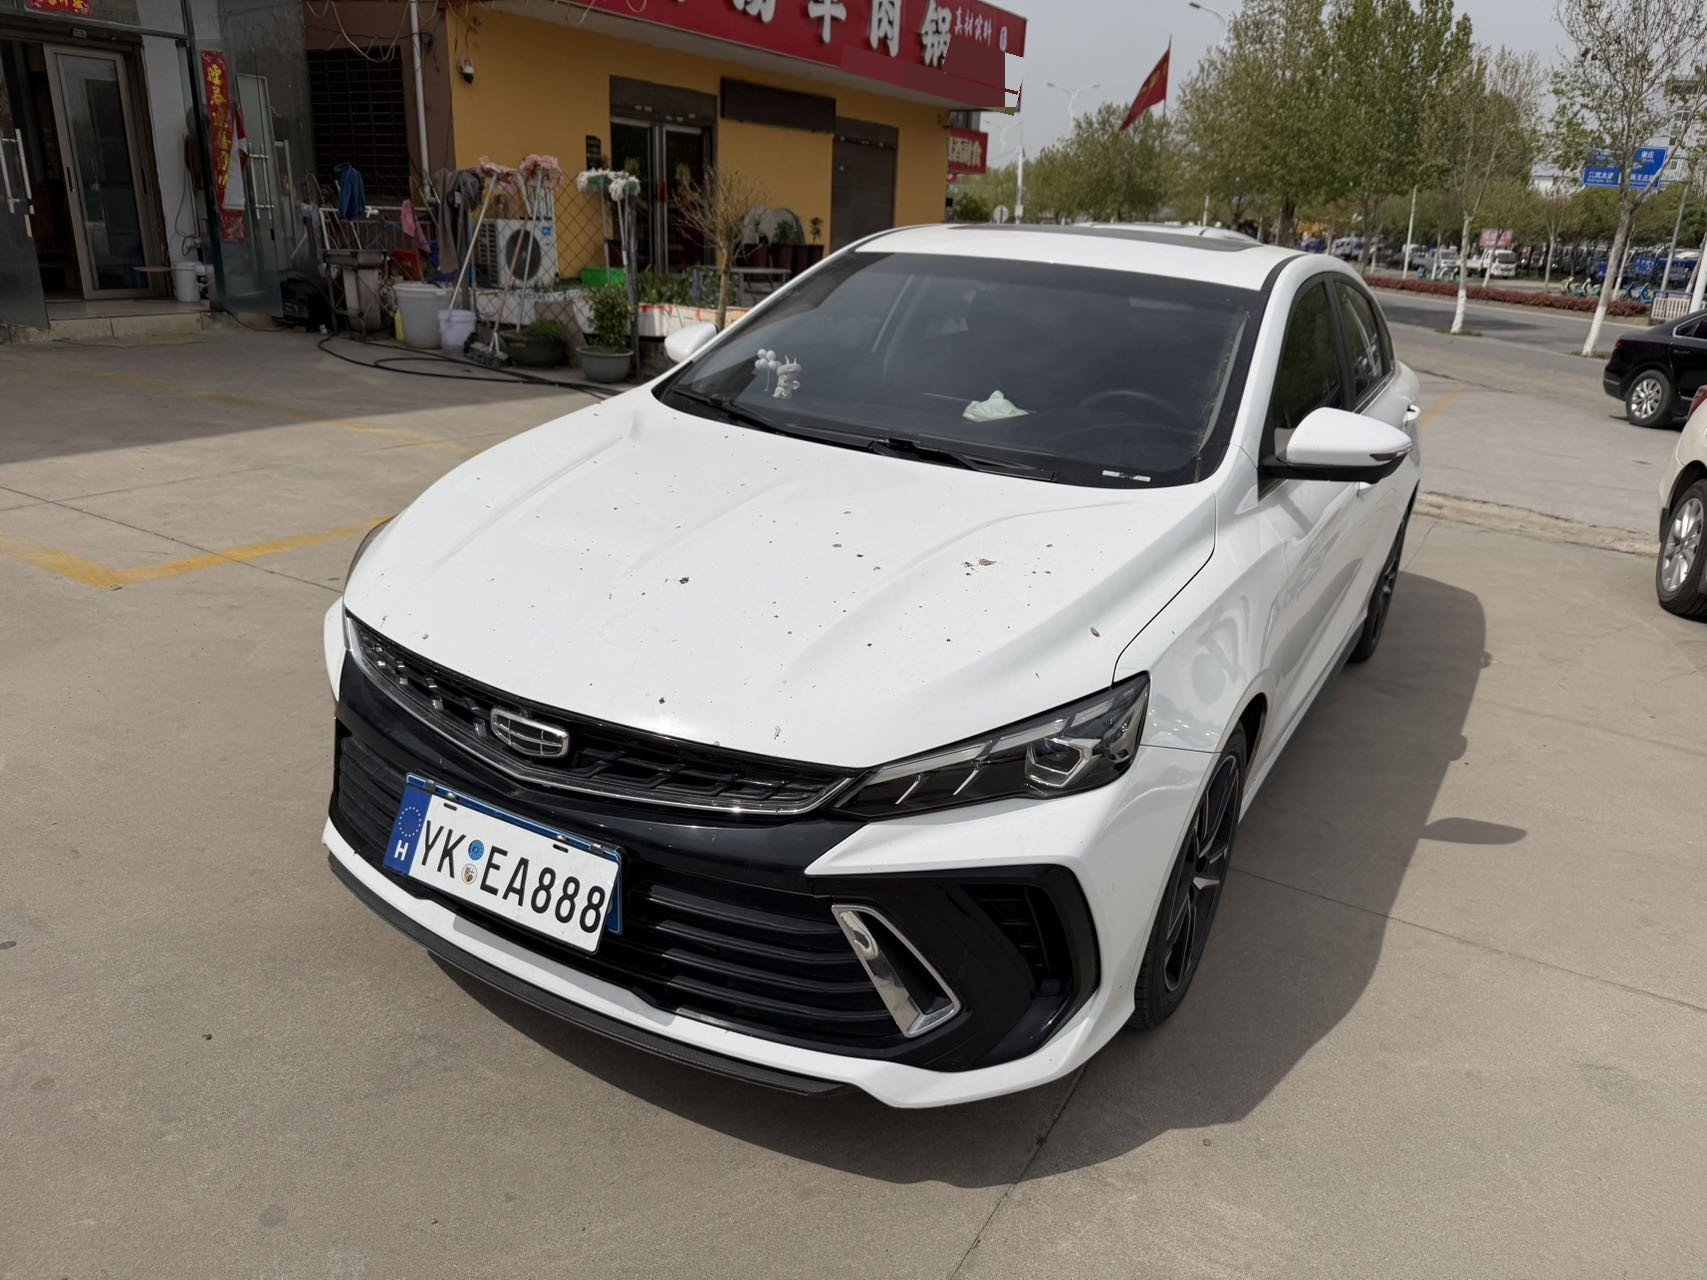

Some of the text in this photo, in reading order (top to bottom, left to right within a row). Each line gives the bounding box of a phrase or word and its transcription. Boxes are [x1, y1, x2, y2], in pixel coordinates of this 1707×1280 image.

[394, 839, 409, 861] H
[421, 819, 606, 934] YK EA888
